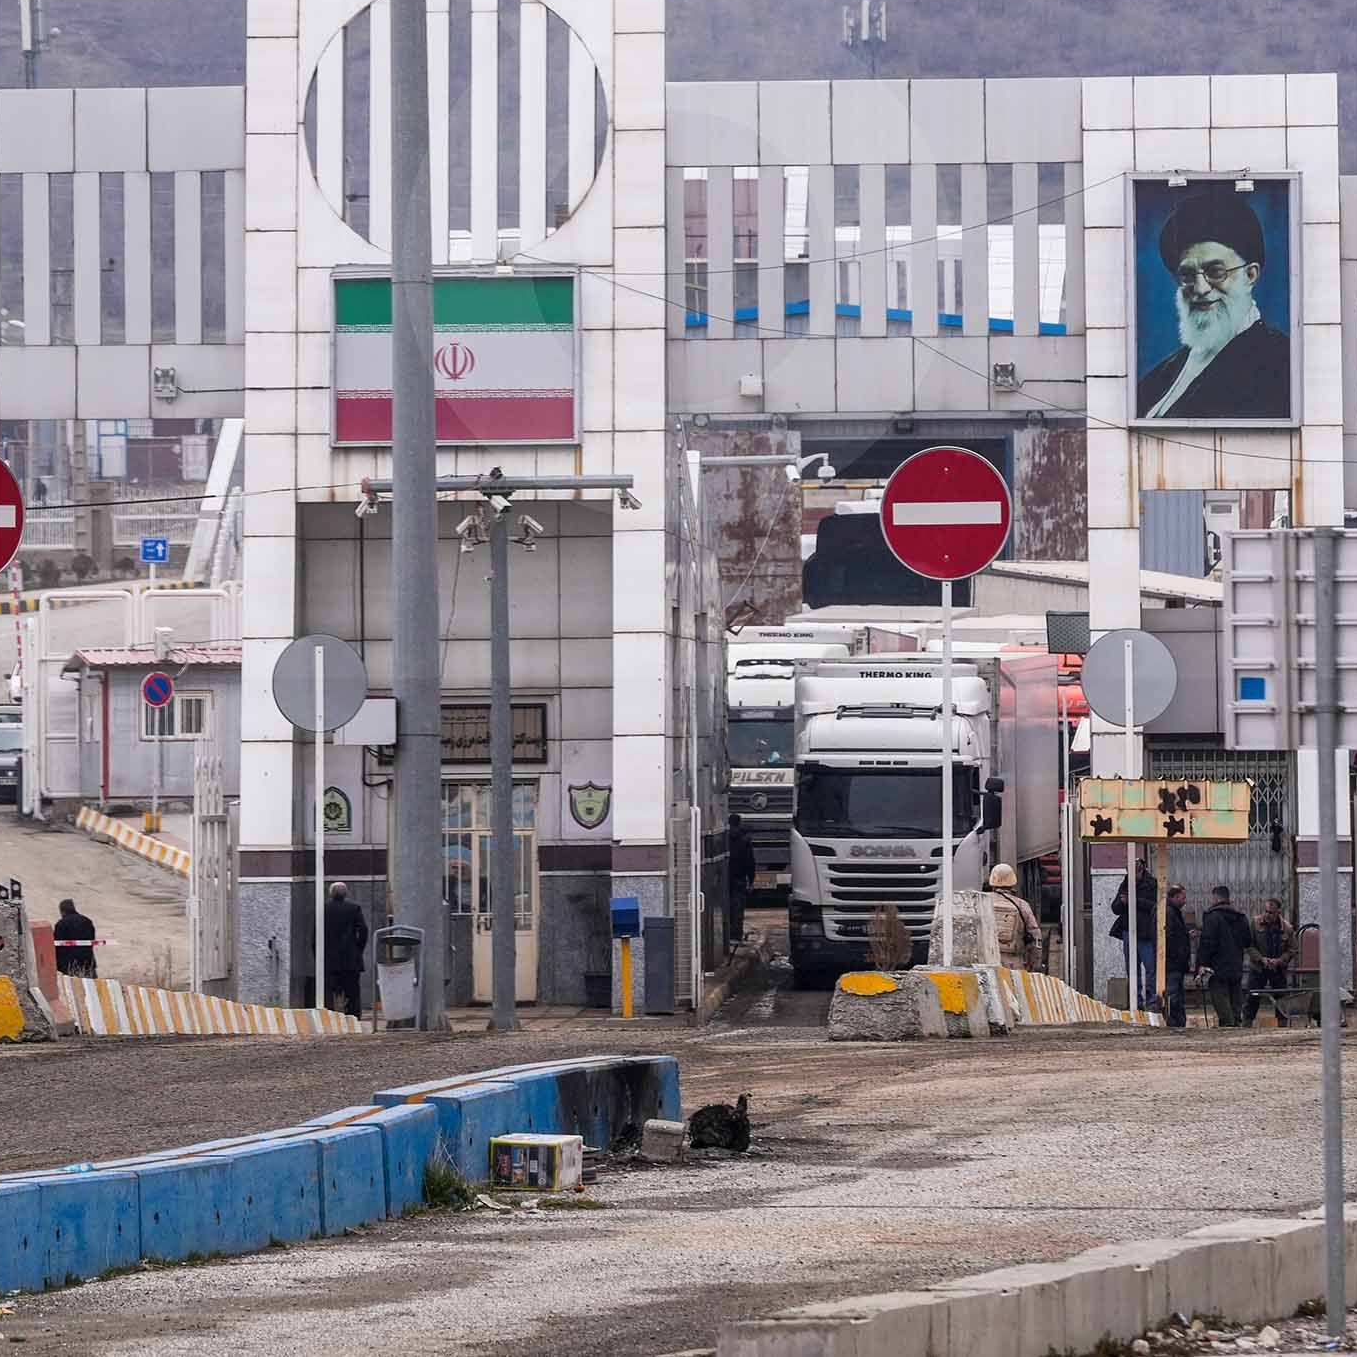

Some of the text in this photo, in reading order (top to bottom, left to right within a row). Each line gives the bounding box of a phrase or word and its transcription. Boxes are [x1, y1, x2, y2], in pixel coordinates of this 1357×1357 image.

[858, 671, 932, 679] THERMO KING
[849, 845, 917, 858] SCANIA
